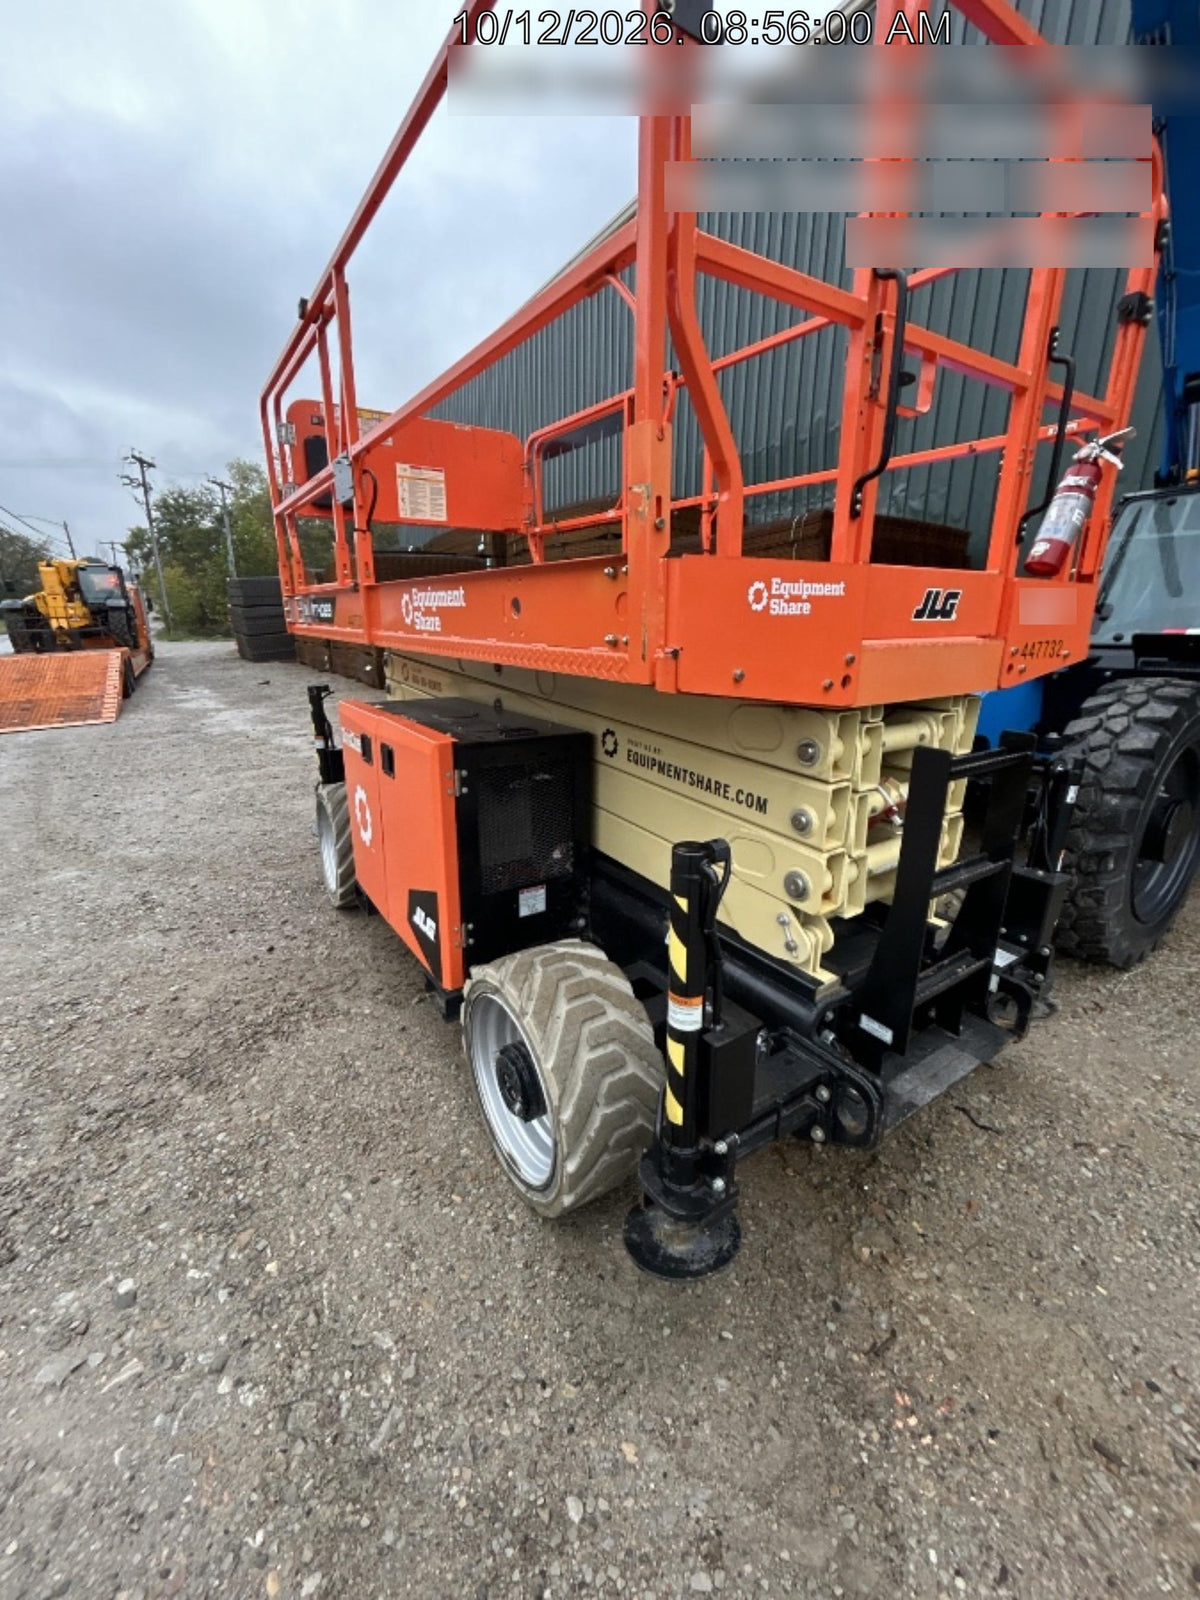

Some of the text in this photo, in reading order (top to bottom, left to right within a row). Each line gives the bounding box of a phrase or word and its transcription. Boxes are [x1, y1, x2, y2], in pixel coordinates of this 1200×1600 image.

[411, 586, 467, 611] Equipment
[771, 577, 846, 599] Equipment
[769, 598, 812, 616] Share
[911, 588, 963, 622] JLG
[413, 611, 442, 632] Share
[1020, 639, 1064, 660] 447732
[626, 749, 769, 815] EQUIPMENTSHARE.COM
